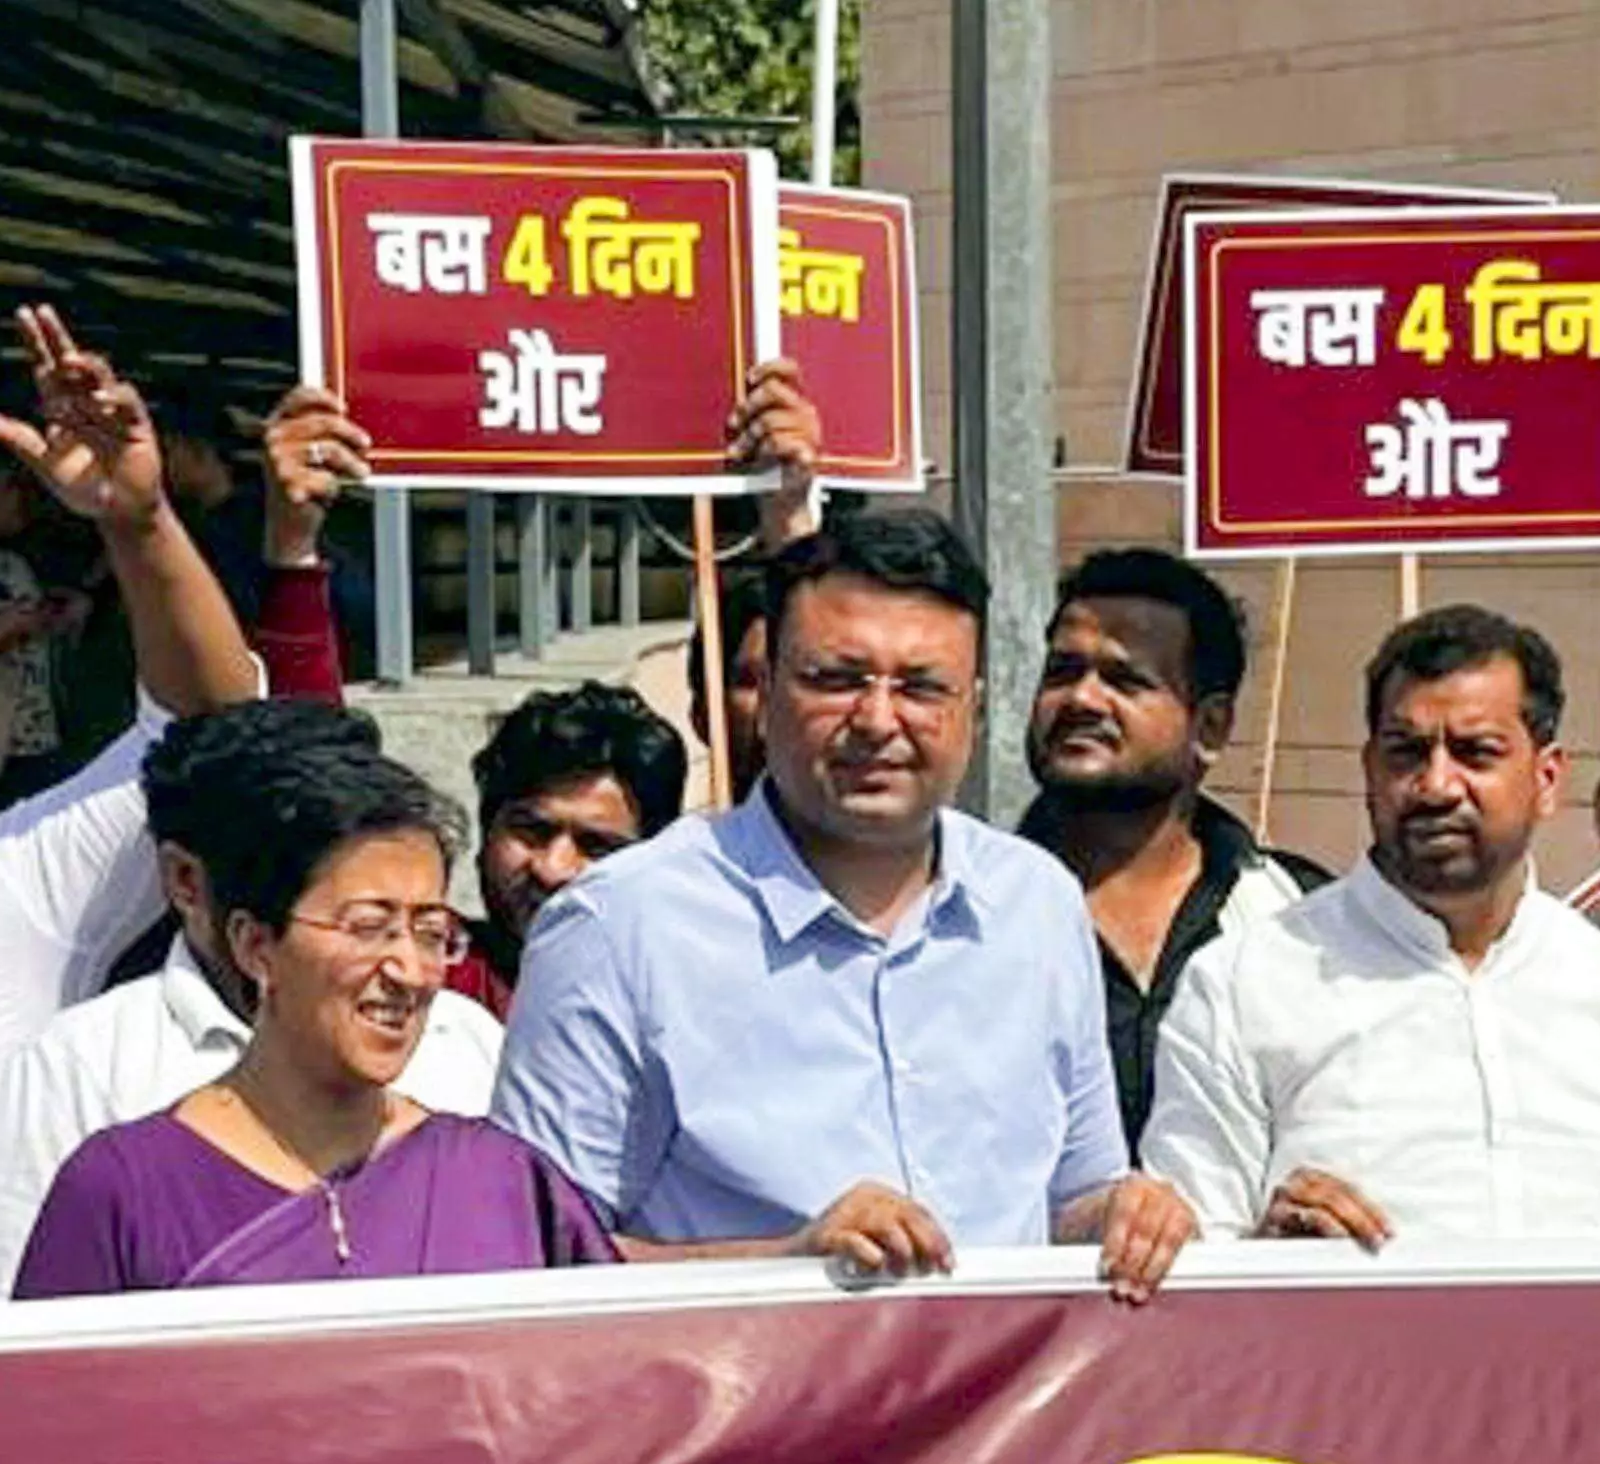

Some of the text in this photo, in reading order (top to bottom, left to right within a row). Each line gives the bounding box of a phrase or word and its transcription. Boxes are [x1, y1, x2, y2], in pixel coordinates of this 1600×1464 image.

[367, 196, 700, 298] बस 4 दिन
[1250, 288, 1385, 367] बस
[1397, 285, 1450, 363] 4
[479, 329, 606, 435] और
[1364, 398, 1508, 499] और
